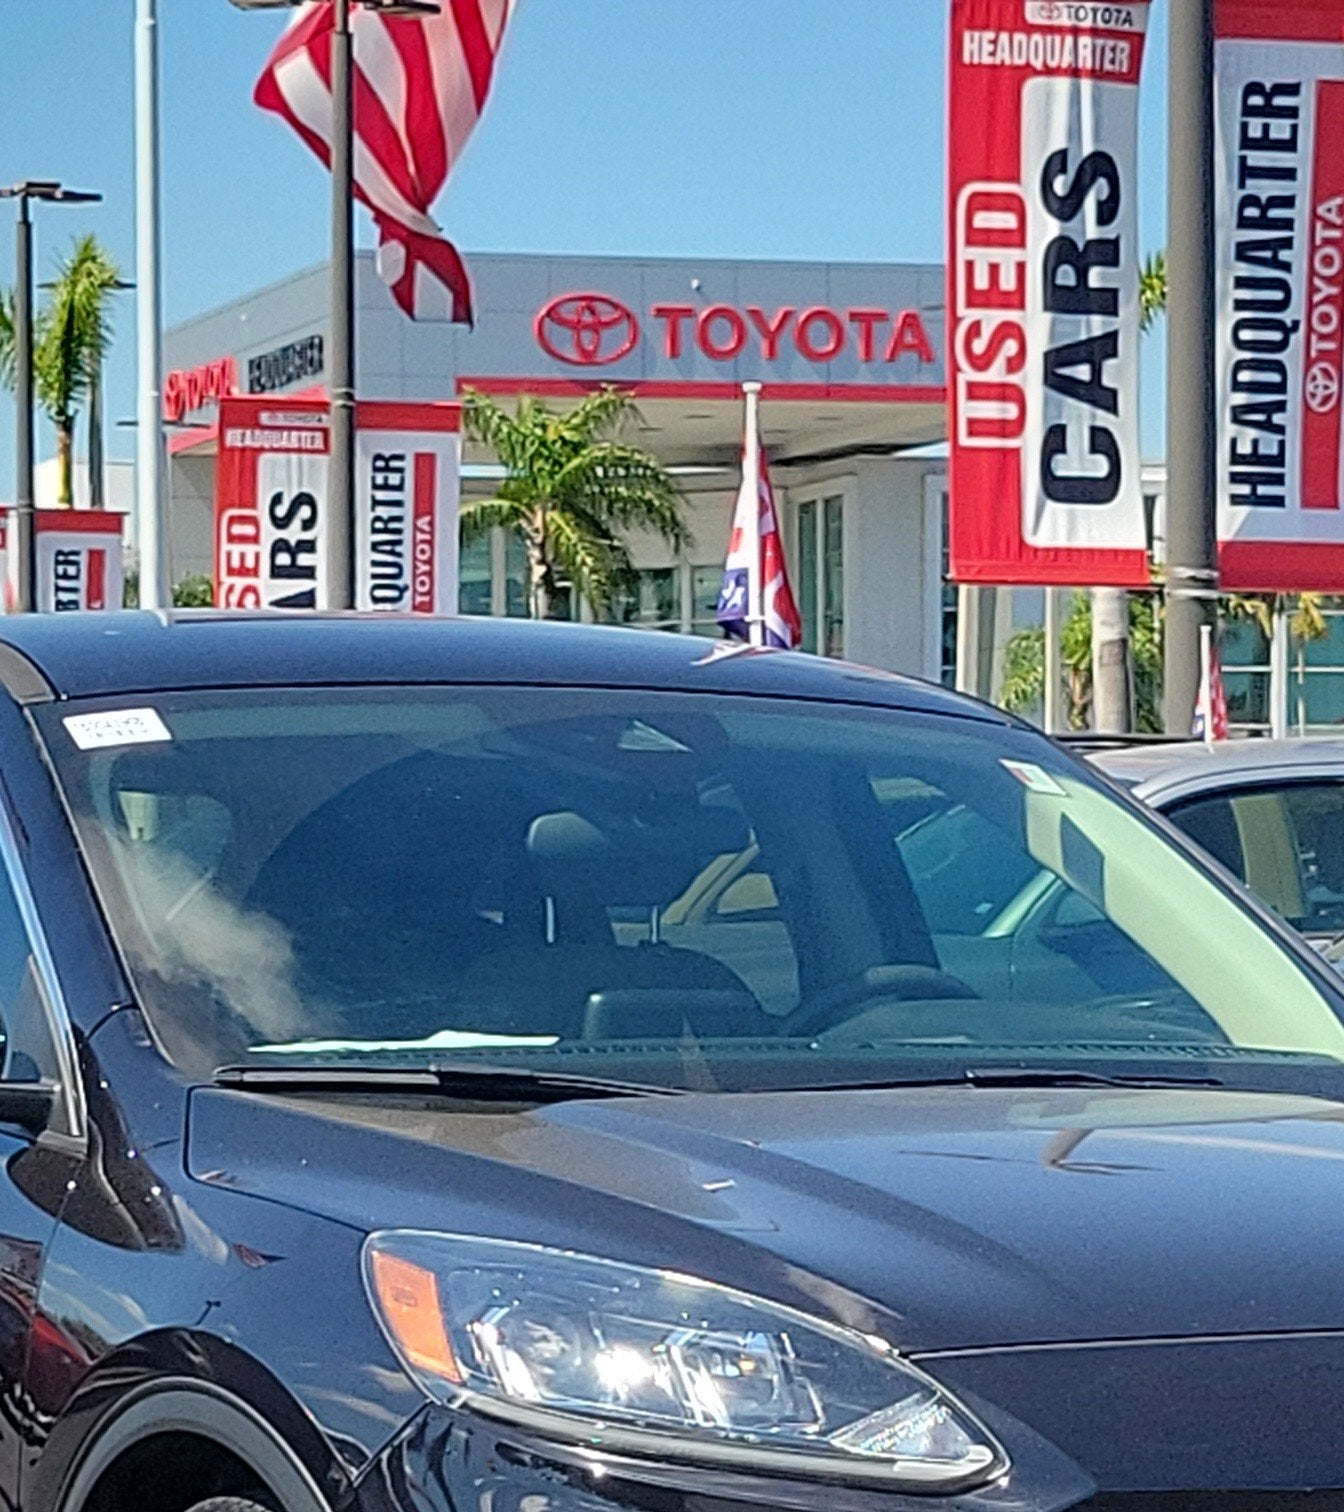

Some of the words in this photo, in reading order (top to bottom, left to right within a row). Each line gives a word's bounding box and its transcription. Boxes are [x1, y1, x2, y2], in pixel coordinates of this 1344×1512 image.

[962, 30, 1131, 73] HEADQUARTER
[1065, 5, 1134, 27] TOYOTA
[651, 305, 935, 362] TOYOTA
[959, 182, 1027, 446] USED
[1041, 148, 1122, 505] CARS
[1229, 80, 1302, 509] HEADQUARTER
[1311, 195, 1344, 356] TOYOTA
[369, 452, 409, 606] QUARTER
